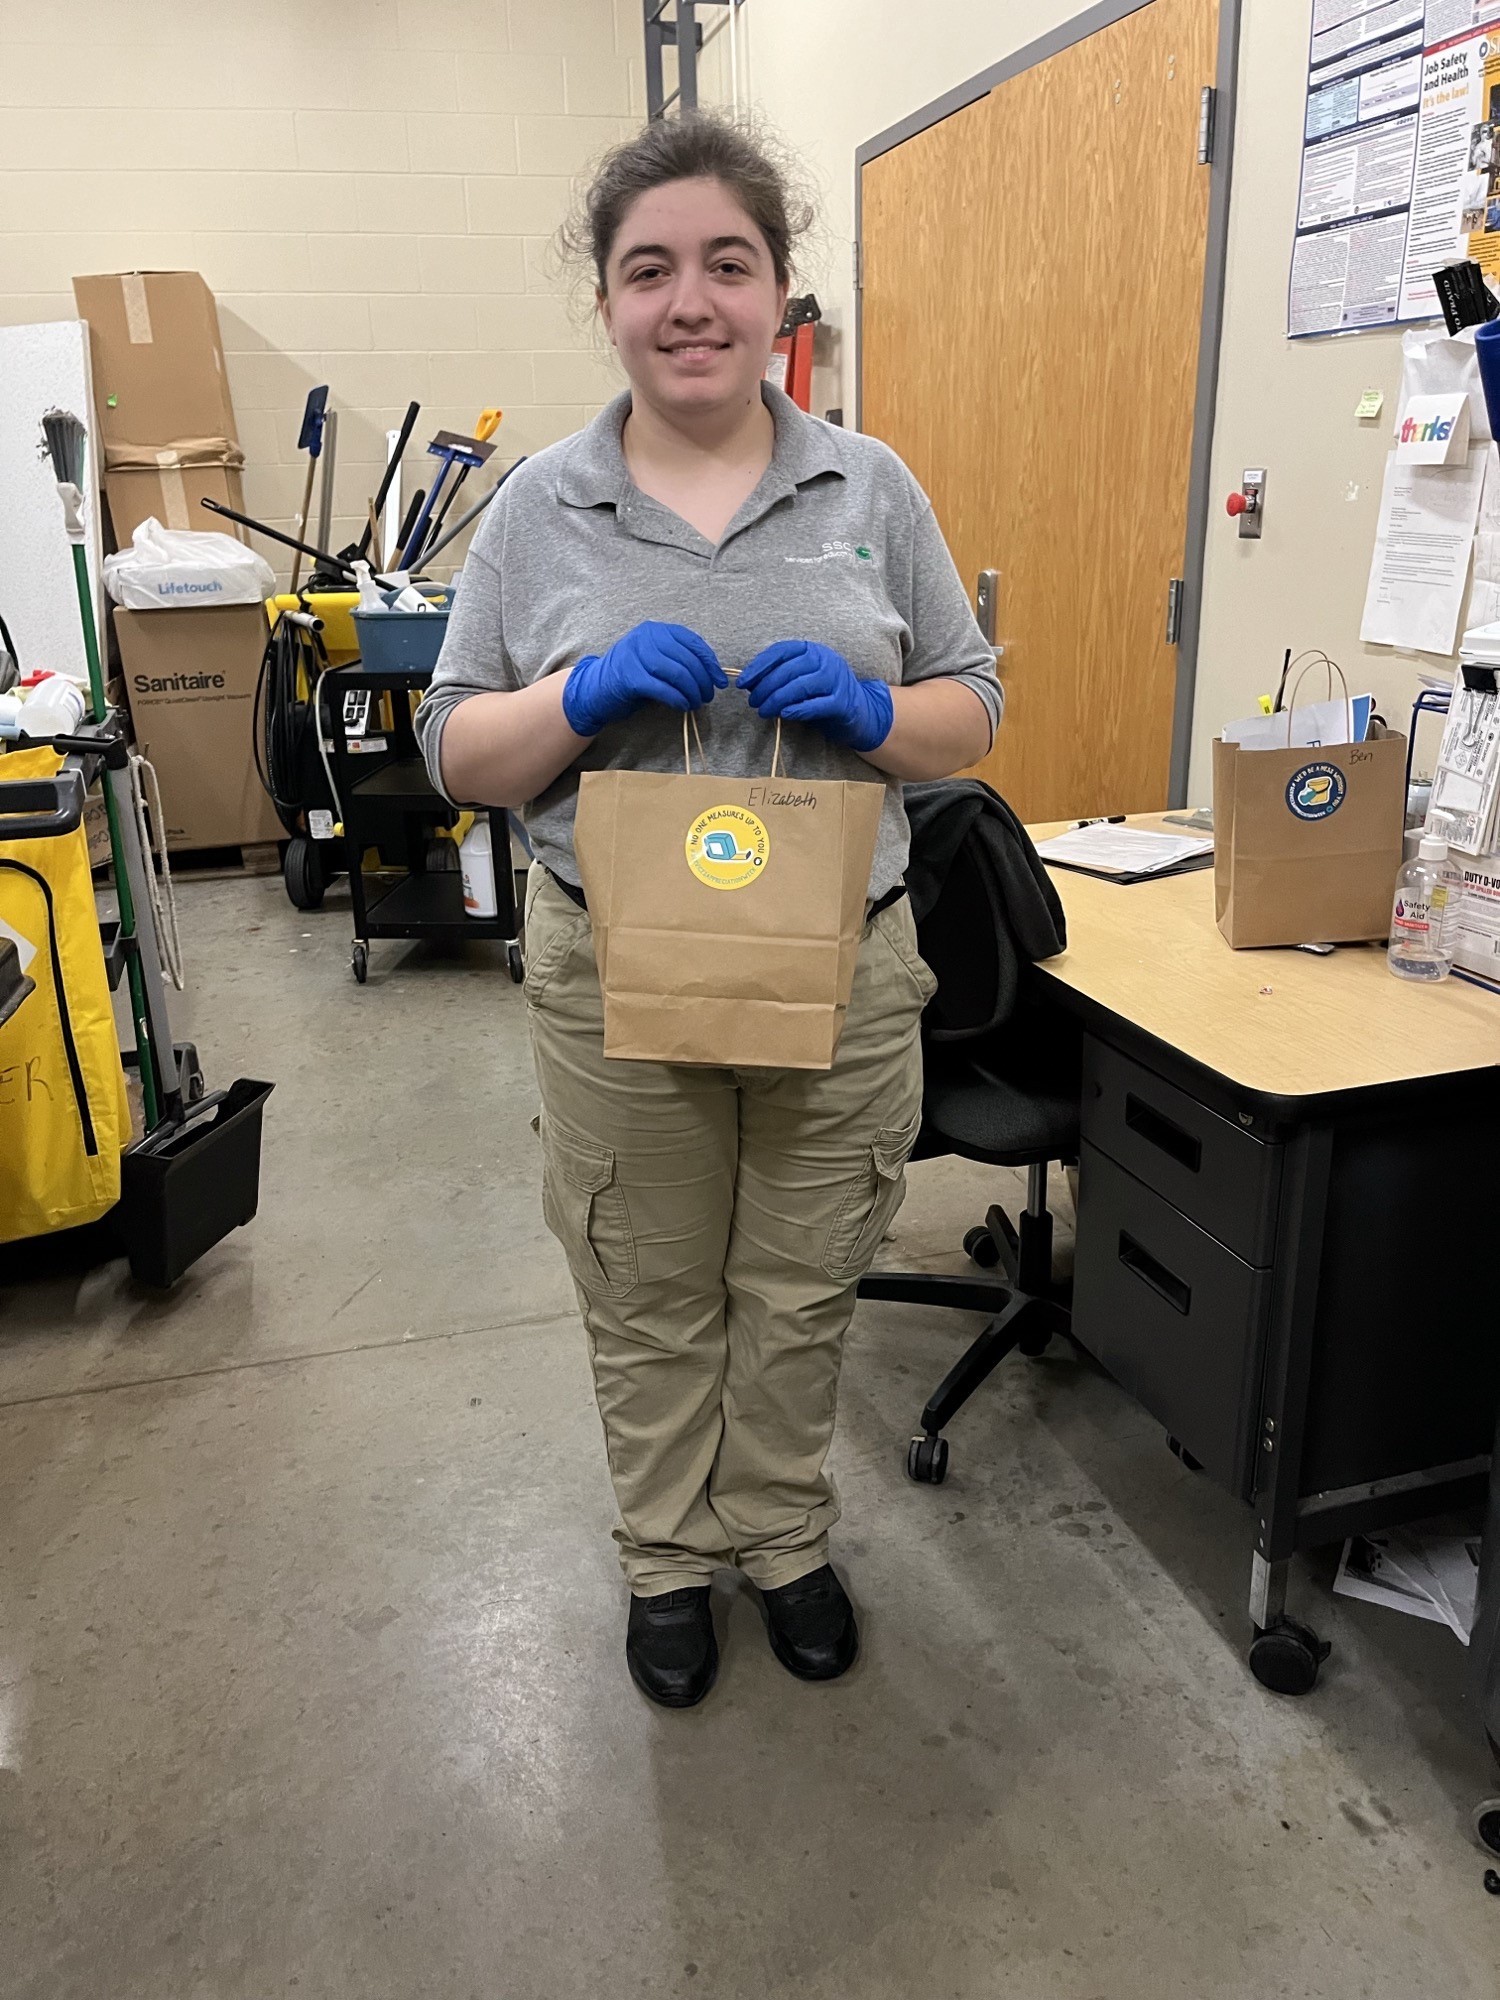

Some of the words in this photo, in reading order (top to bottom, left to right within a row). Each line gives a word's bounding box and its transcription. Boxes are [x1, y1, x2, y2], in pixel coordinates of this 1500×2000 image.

[1424, 61, 1439, 76] Job
[1440, 52, 1468, 70] Safety
[1424, 75, 1439, 91] and
[1441, 66, 1469, 85] Health
[821, 540, 851, 552] SSC
[158, 581, 223, 595] Lifetouch
[134, 671, 225, 693] Sanitaire
[1349, 749, 1373, 765] Ben
[748, 787, 817, 810] Elizabeth
[707, 810, 745, 822] MEASURES
[745, 816, 755, 826] UP
[695, 819, 708, 834] ONE
[753, 825, 762, 836] TO
[691, 834, 699, 846] NO
[757, 837, 765, 854] YOU
[1464, 871, 1483, 886] DUTY
[1404, 900, 1431, 913] Safety
[1410, 912, 1425, 920] Aid
